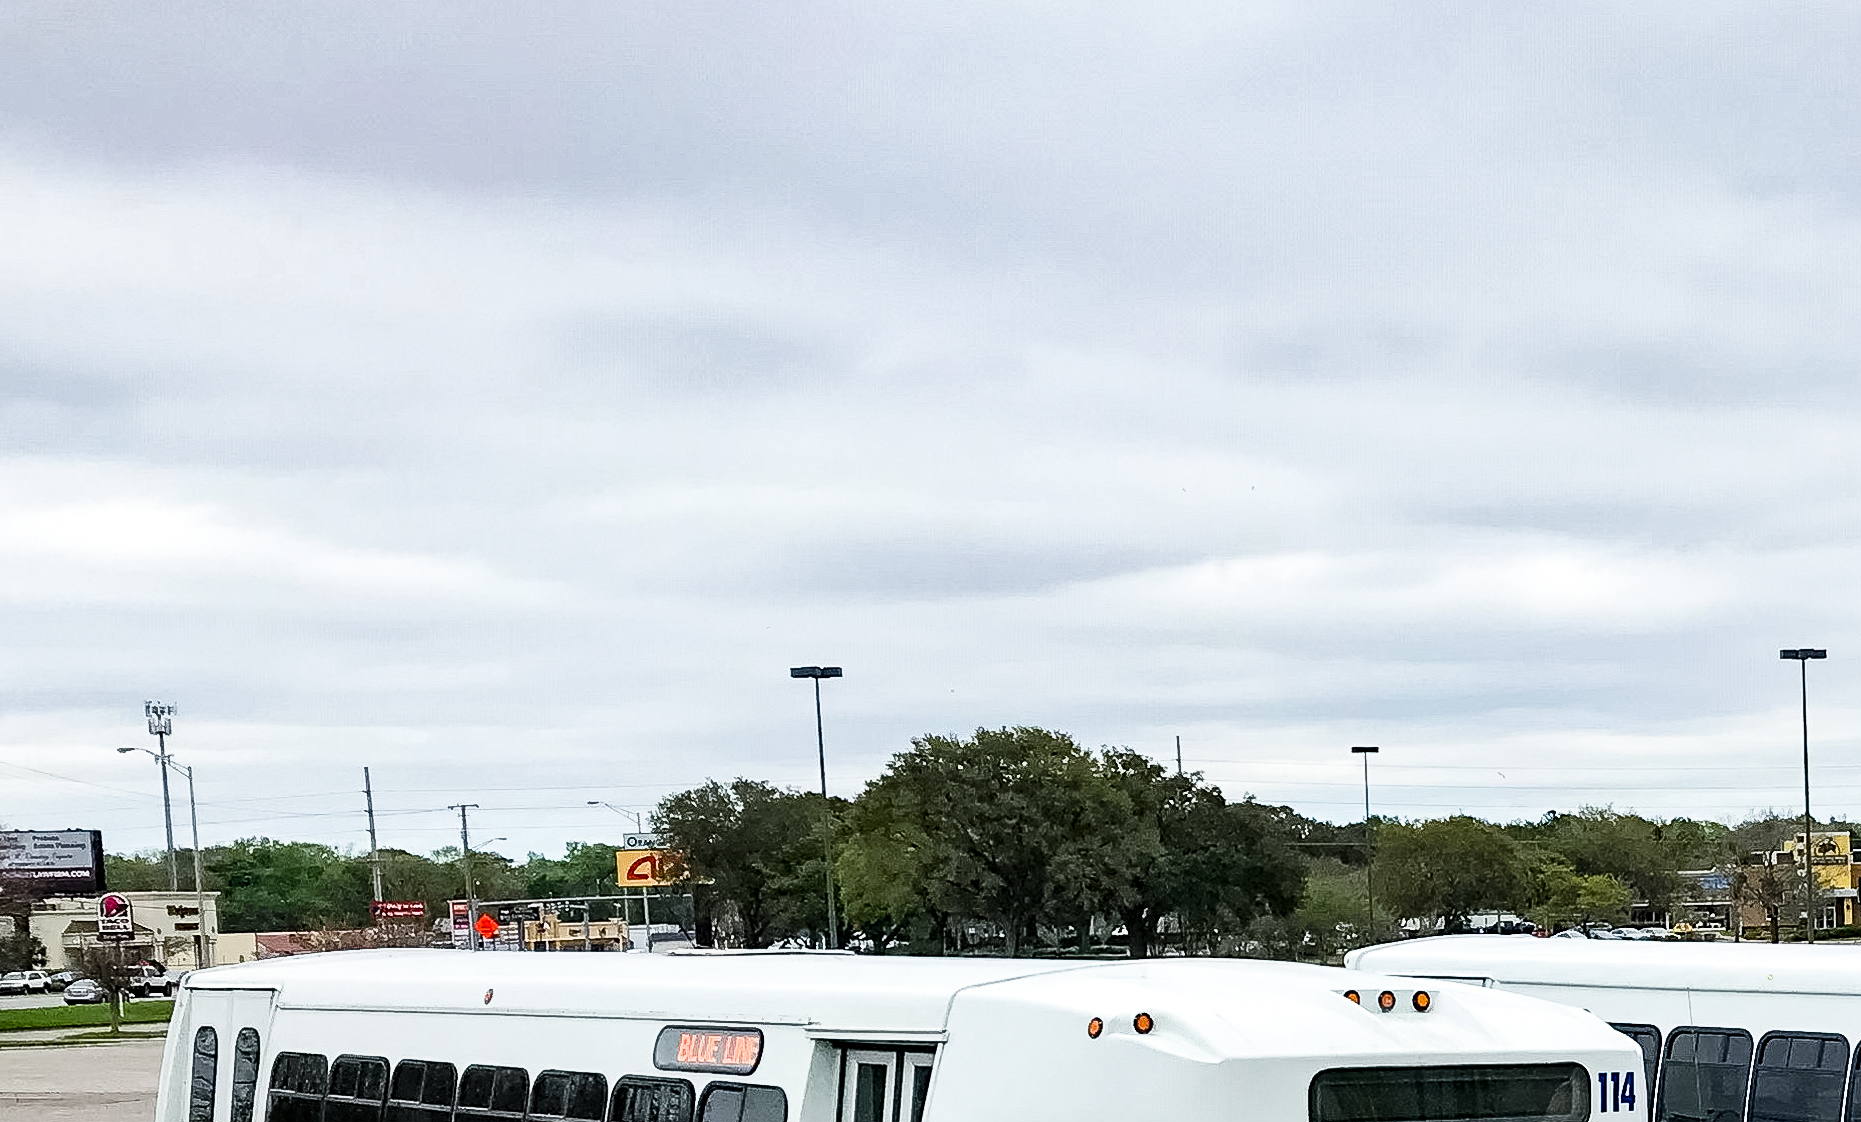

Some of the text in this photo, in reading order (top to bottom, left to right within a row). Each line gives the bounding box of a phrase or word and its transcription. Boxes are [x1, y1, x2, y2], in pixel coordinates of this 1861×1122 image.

[677, 1033, 760, 1066] BLUE LINE
[1598, 1072, 1636, 1113] 114
